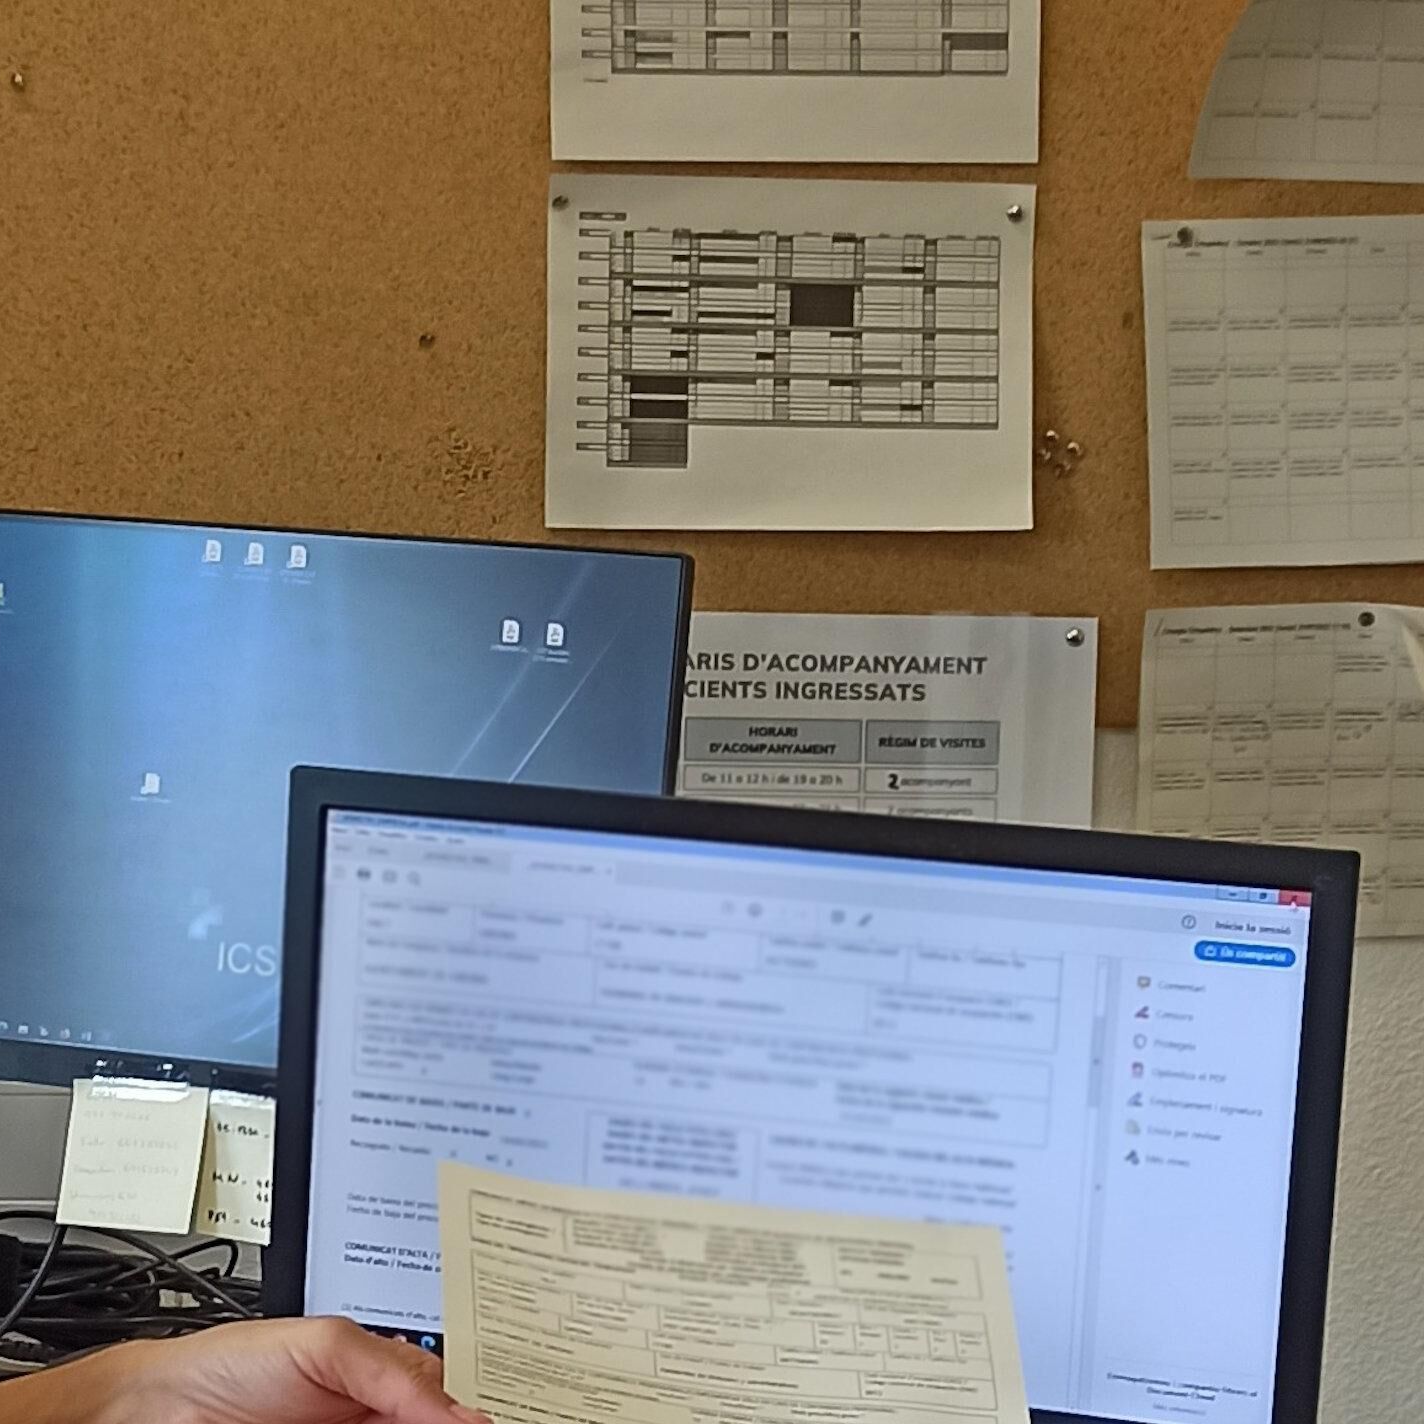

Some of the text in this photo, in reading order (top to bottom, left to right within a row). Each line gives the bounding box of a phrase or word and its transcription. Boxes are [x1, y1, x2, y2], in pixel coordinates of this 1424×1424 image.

[686, 652, 988, 675] ARIS D'ACOMPANYAMENT
[685, 680, 926, 701] CIENTS INGRESSATS
[748, 726, 798, 737] HORARI
[709, 743, 836, 755] D'ACOMPANYAMENT
[920, 738, 937, 748] DE
[940, 738, 986, 749] VISITES
[888, 773, 899, 790] 2
[217, 942, 276, 976] ICS
